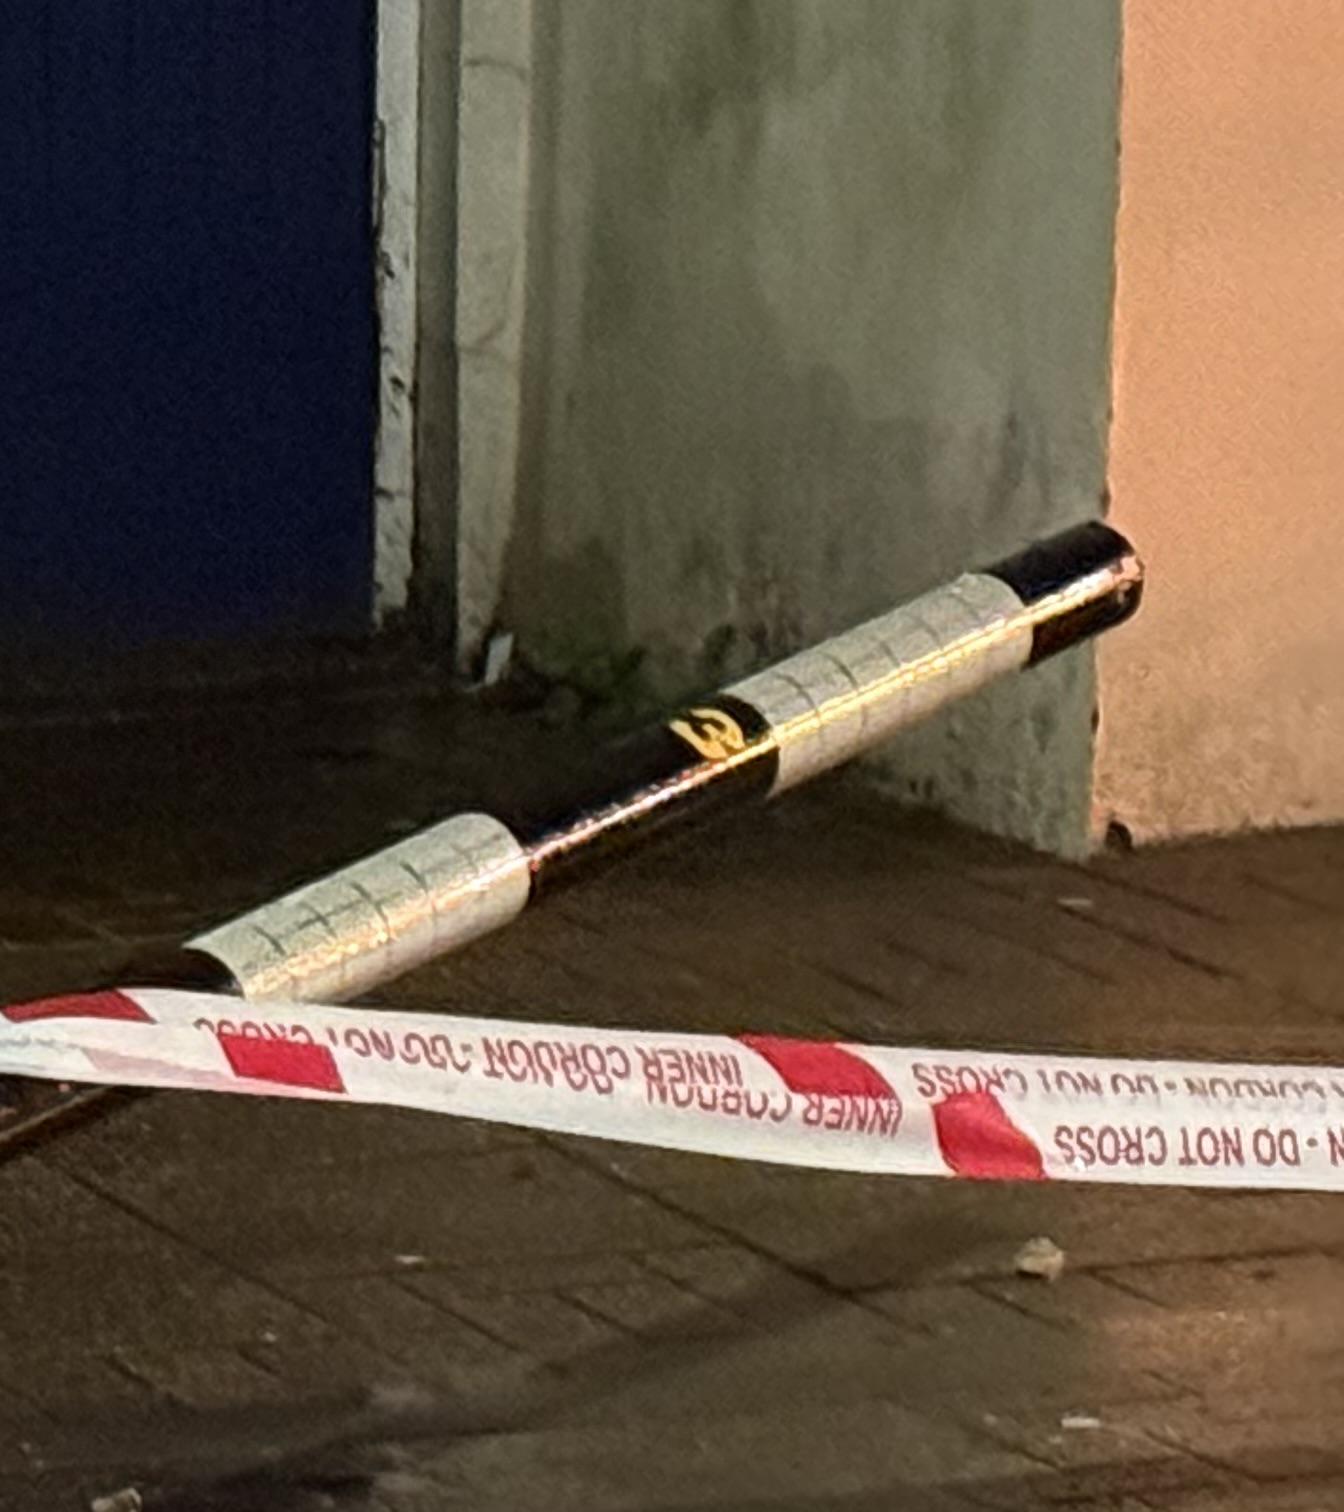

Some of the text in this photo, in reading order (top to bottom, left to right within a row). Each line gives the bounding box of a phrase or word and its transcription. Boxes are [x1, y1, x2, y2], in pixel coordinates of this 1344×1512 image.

[634, 1043, 745, 1091] INNER
[1053, 1124, 1170, 1167] CROSS
[1178, 1126, 1245, 1167] NOT
[1253, 1127, 1301, 1167] DO
